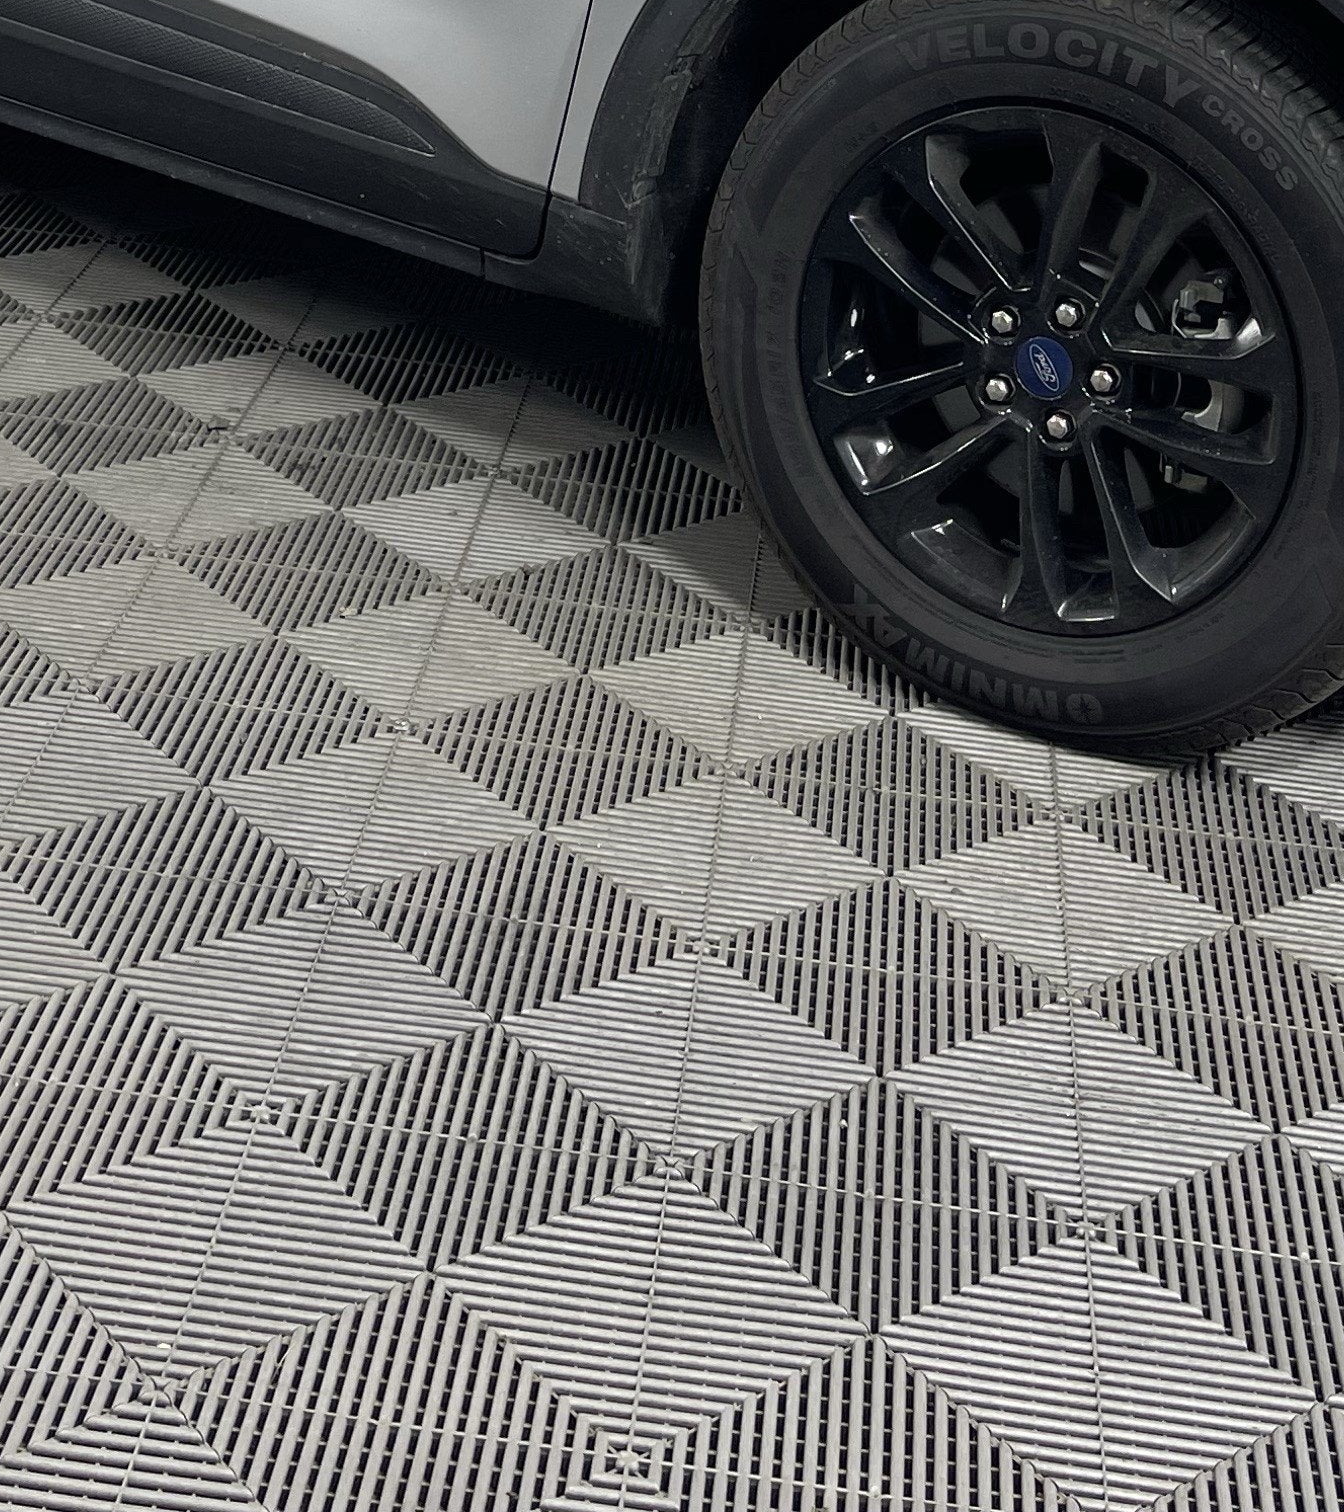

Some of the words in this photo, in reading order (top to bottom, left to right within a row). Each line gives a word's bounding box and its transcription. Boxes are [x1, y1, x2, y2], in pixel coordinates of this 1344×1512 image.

[896, 22, 1201, 108] VELOCITY
[1201, 94, 1299, 191] CROSS
[838, 584, 1102, 724] OMNIMAX
